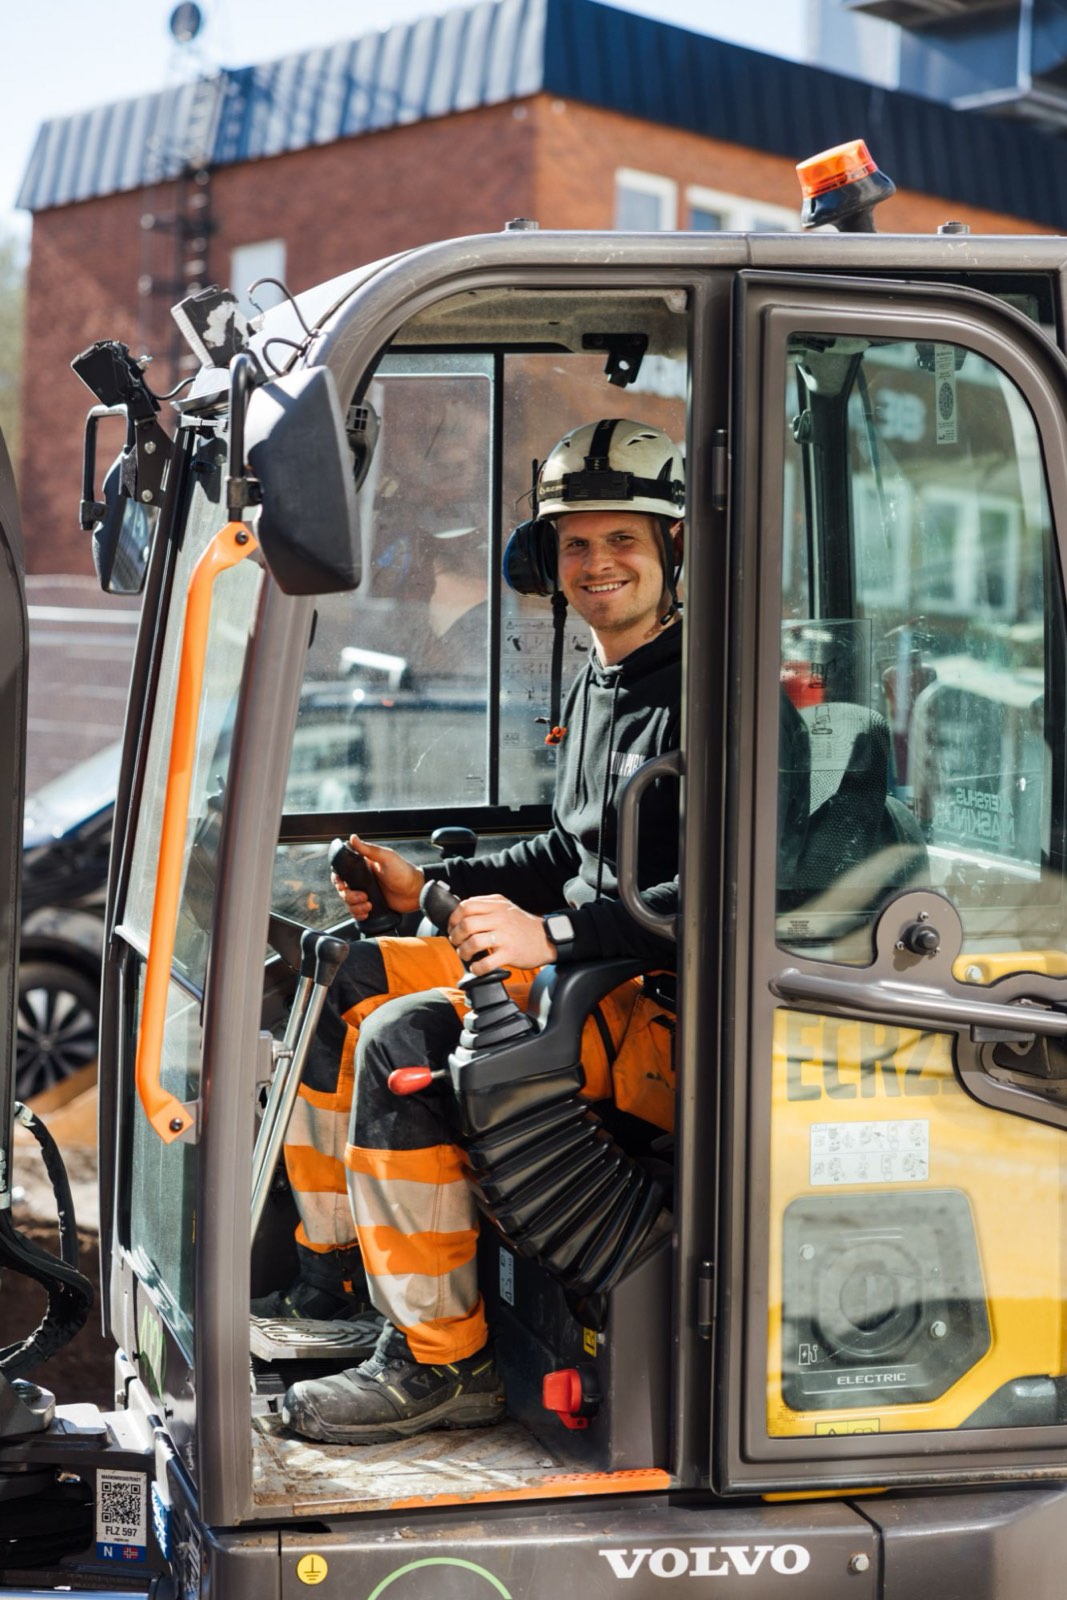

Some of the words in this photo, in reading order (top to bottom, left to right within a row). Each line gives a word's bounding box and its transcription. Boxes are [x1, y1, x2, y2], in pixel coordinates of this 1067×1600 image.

[786, 1012, 962, 1101] ECR2
[836, 1372, 907, 1386] ELECTRIC
[105, 1525, 120, 1536] FLZ
[122, 1527, 138, 1537] 597
[103, 1545, 113, 1558] N
[599, 1544, 811, 1579] VOLVO
